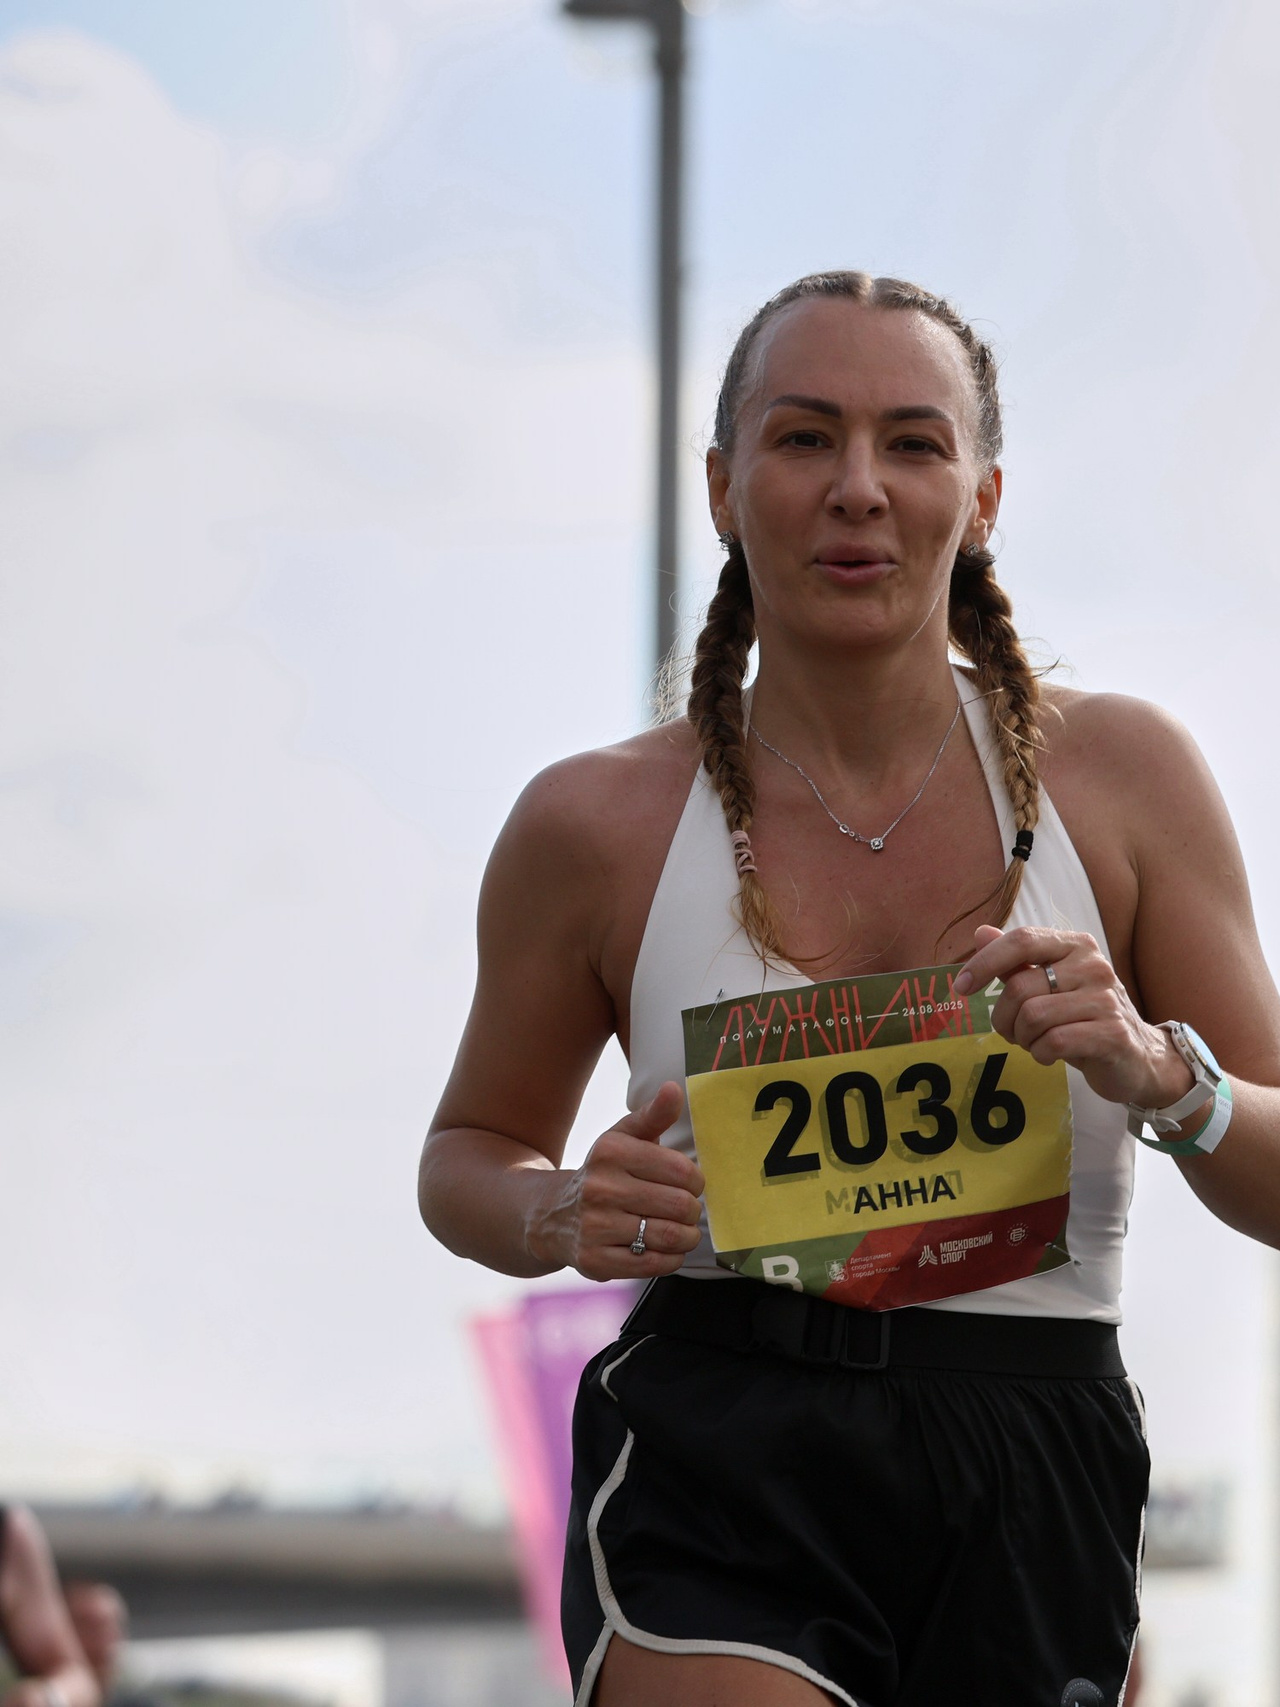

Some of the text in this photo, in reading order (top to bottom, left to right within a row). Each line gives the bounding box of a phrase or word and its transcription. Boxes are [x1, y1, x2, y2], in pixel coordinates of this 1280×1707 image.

[711, 971, 975, 1072] ЛУЖНИКИ
[719, 1013, 863, 1045] ПОЛУМАРАФОН
[902, 1000, 964, 1017] 24.08.2025
[753, 1052, 1026, 1178] 2036
[853, 1175, 957, 1215] АННА
[939, 1231, 994, 1254] МОСКОВСКИЙ
[850, 1252, 893, 1265] Департамент
[851, 1263, 874, 1272] спорта
[940, 1250, 967, 1265] СПОРТ
[852, 1269, 875, 1279] города
